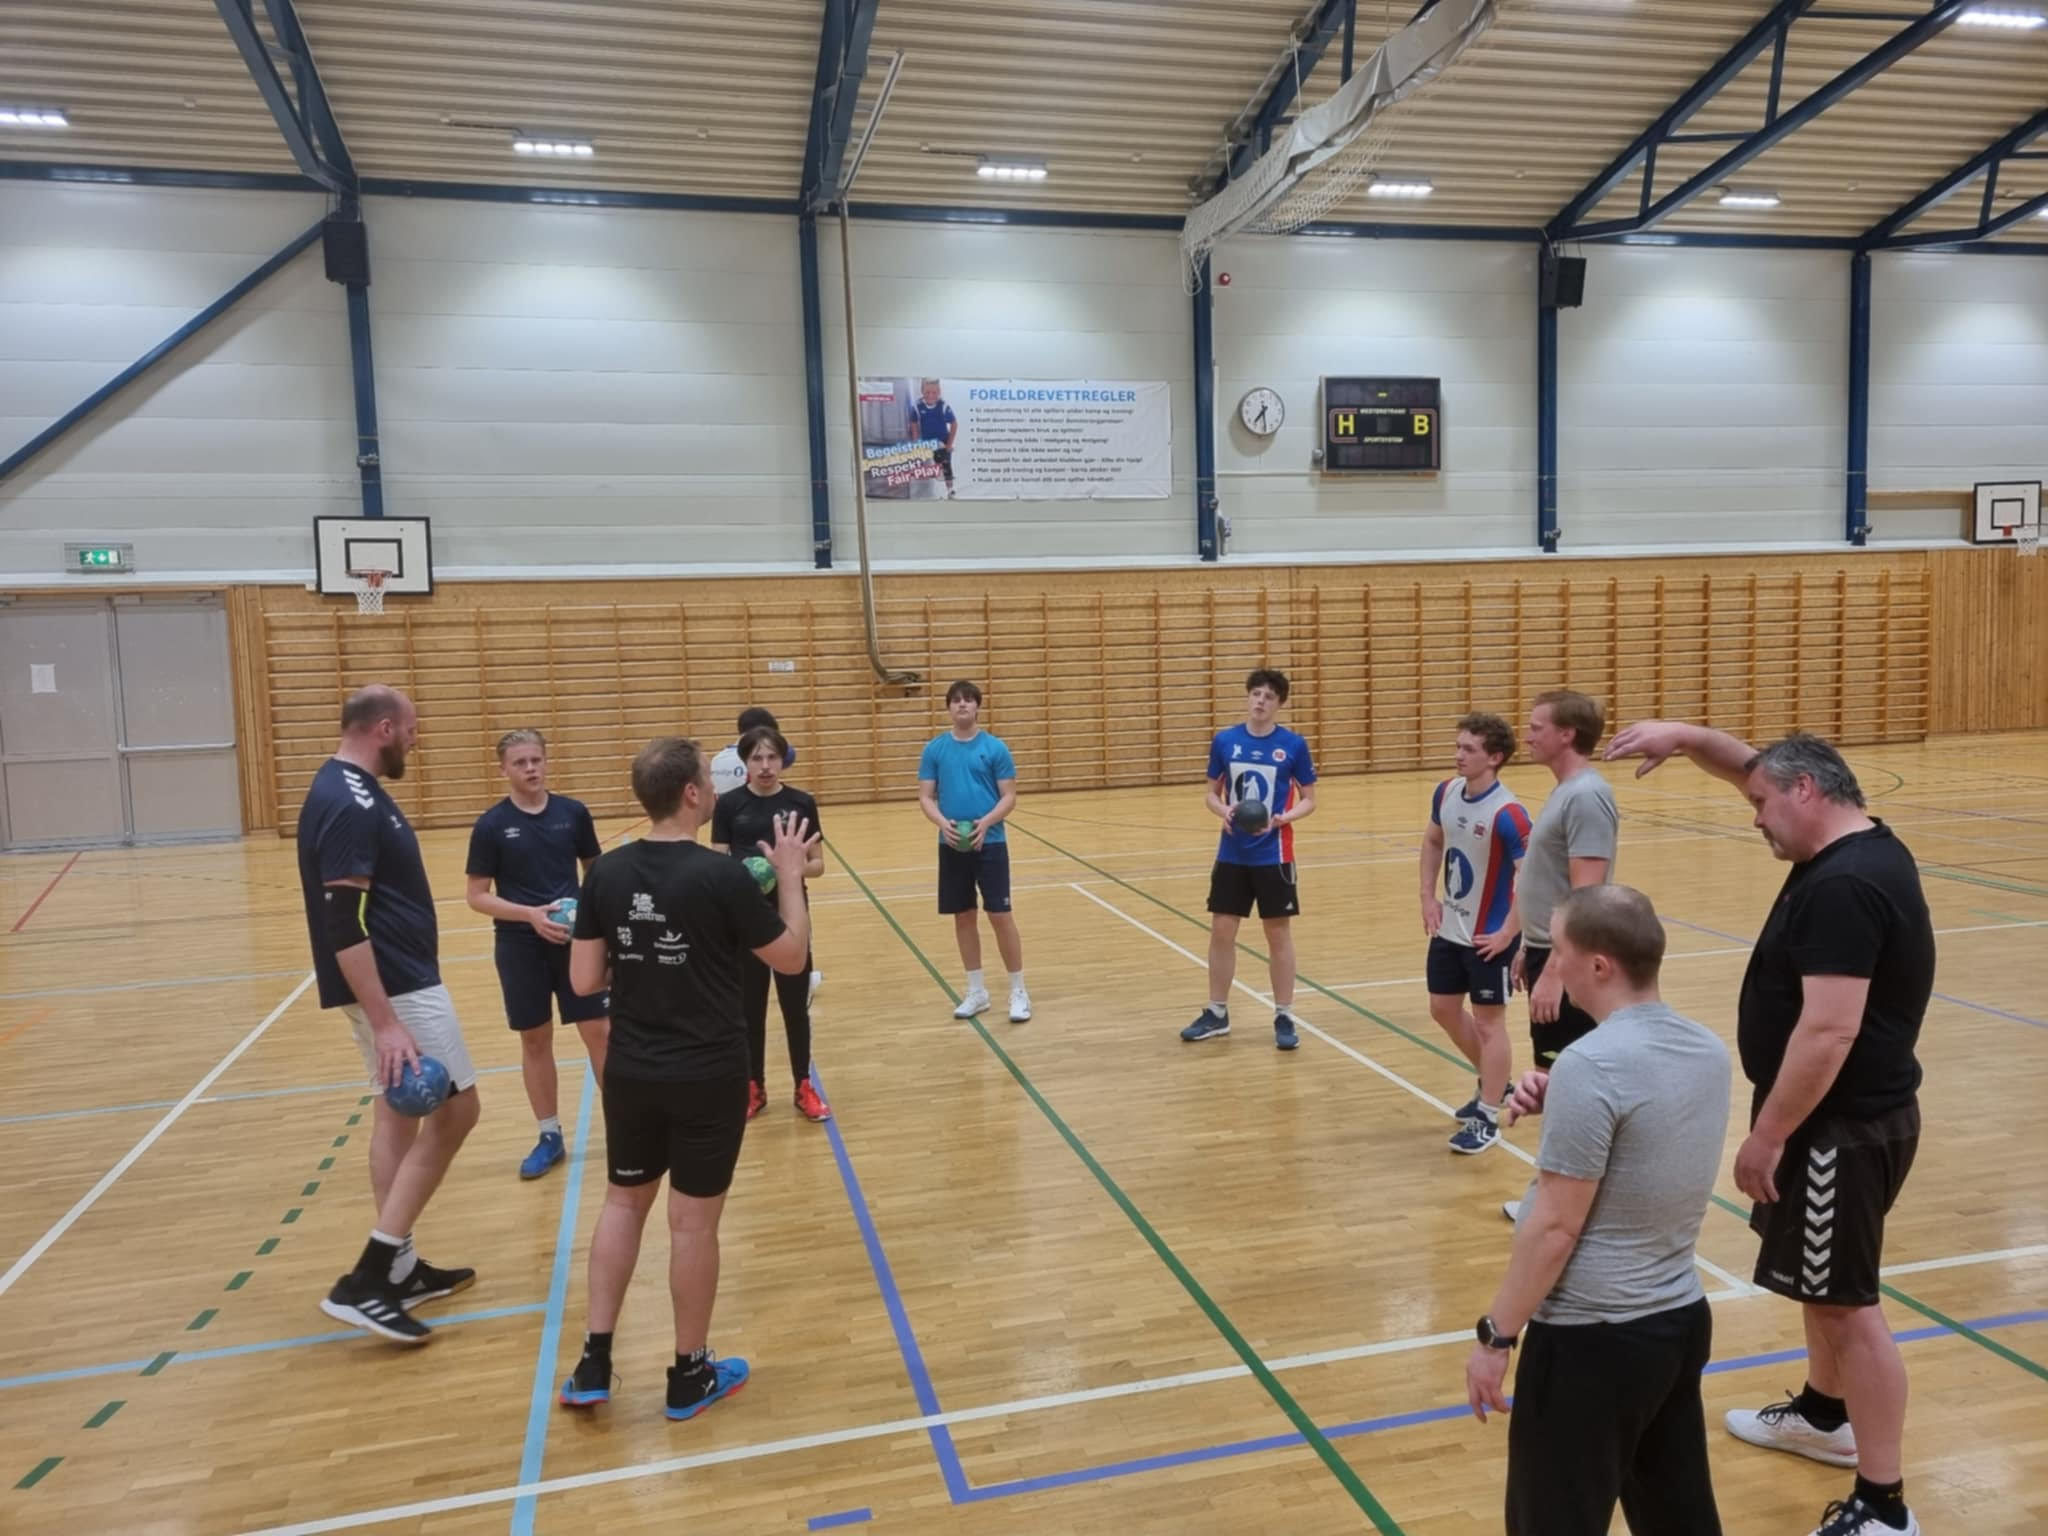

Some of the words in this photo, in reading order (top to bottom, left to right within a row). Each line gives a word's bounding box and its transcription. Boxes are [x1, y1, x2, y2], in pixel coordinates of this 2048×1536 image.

[969, 388, 1136, 402] FORELDREVETTREGLER
[1338, 414, 1354, 435] H
[1414, 414, 1429, 435] B
[866, 439, 938, 459] Begeistring
[871, 460, 921, 478] Respekt
[888, 474, 911, 486] Fair
[914, 466, 940, 479] Play
[628, 909, 666, 922] Sentrum
